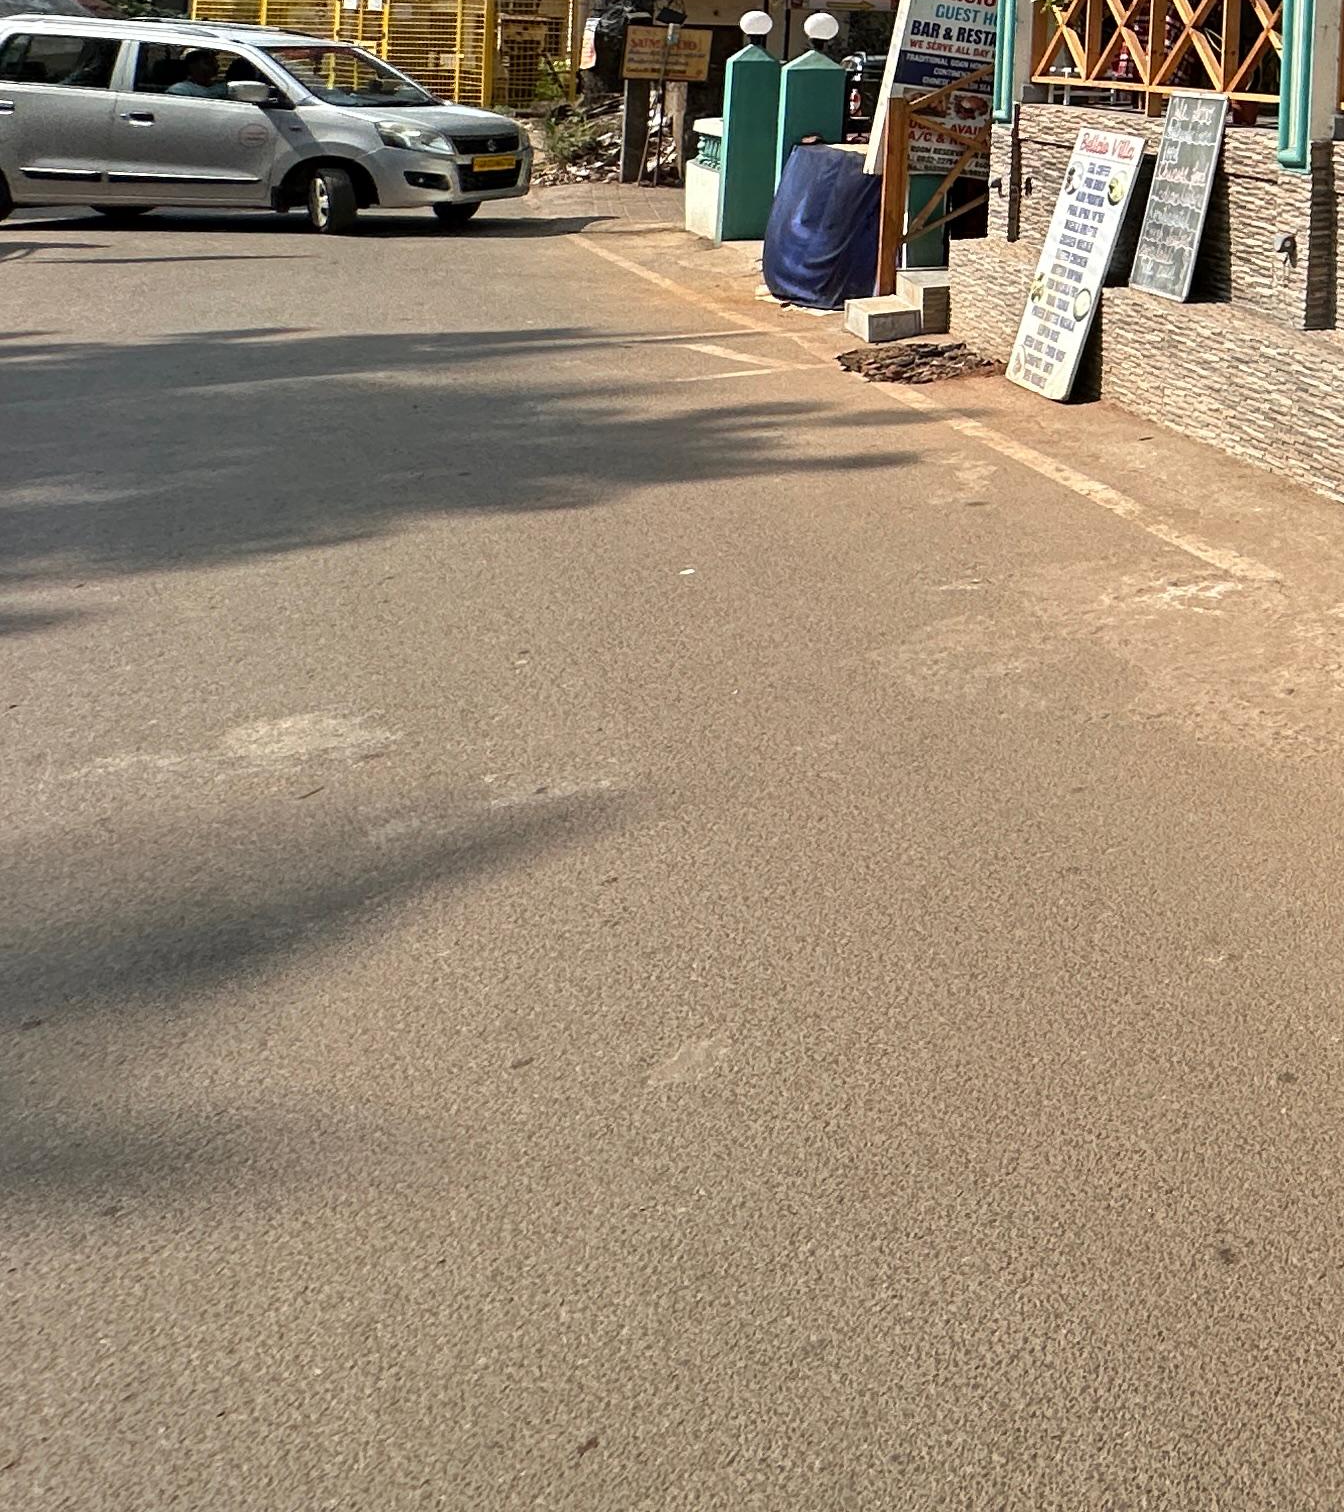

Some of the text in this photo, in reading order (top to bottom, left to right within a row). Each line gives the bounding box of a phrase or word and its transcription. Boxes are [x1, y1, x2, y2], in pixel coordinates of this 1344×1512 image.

[935, 4, 981, 23] GUEST
[911, 20, 941, 38] BAR
[943, 27, 953, 40] &
[910, 39, 924, 49] WE
[954, 45, 971, 55] ALL
